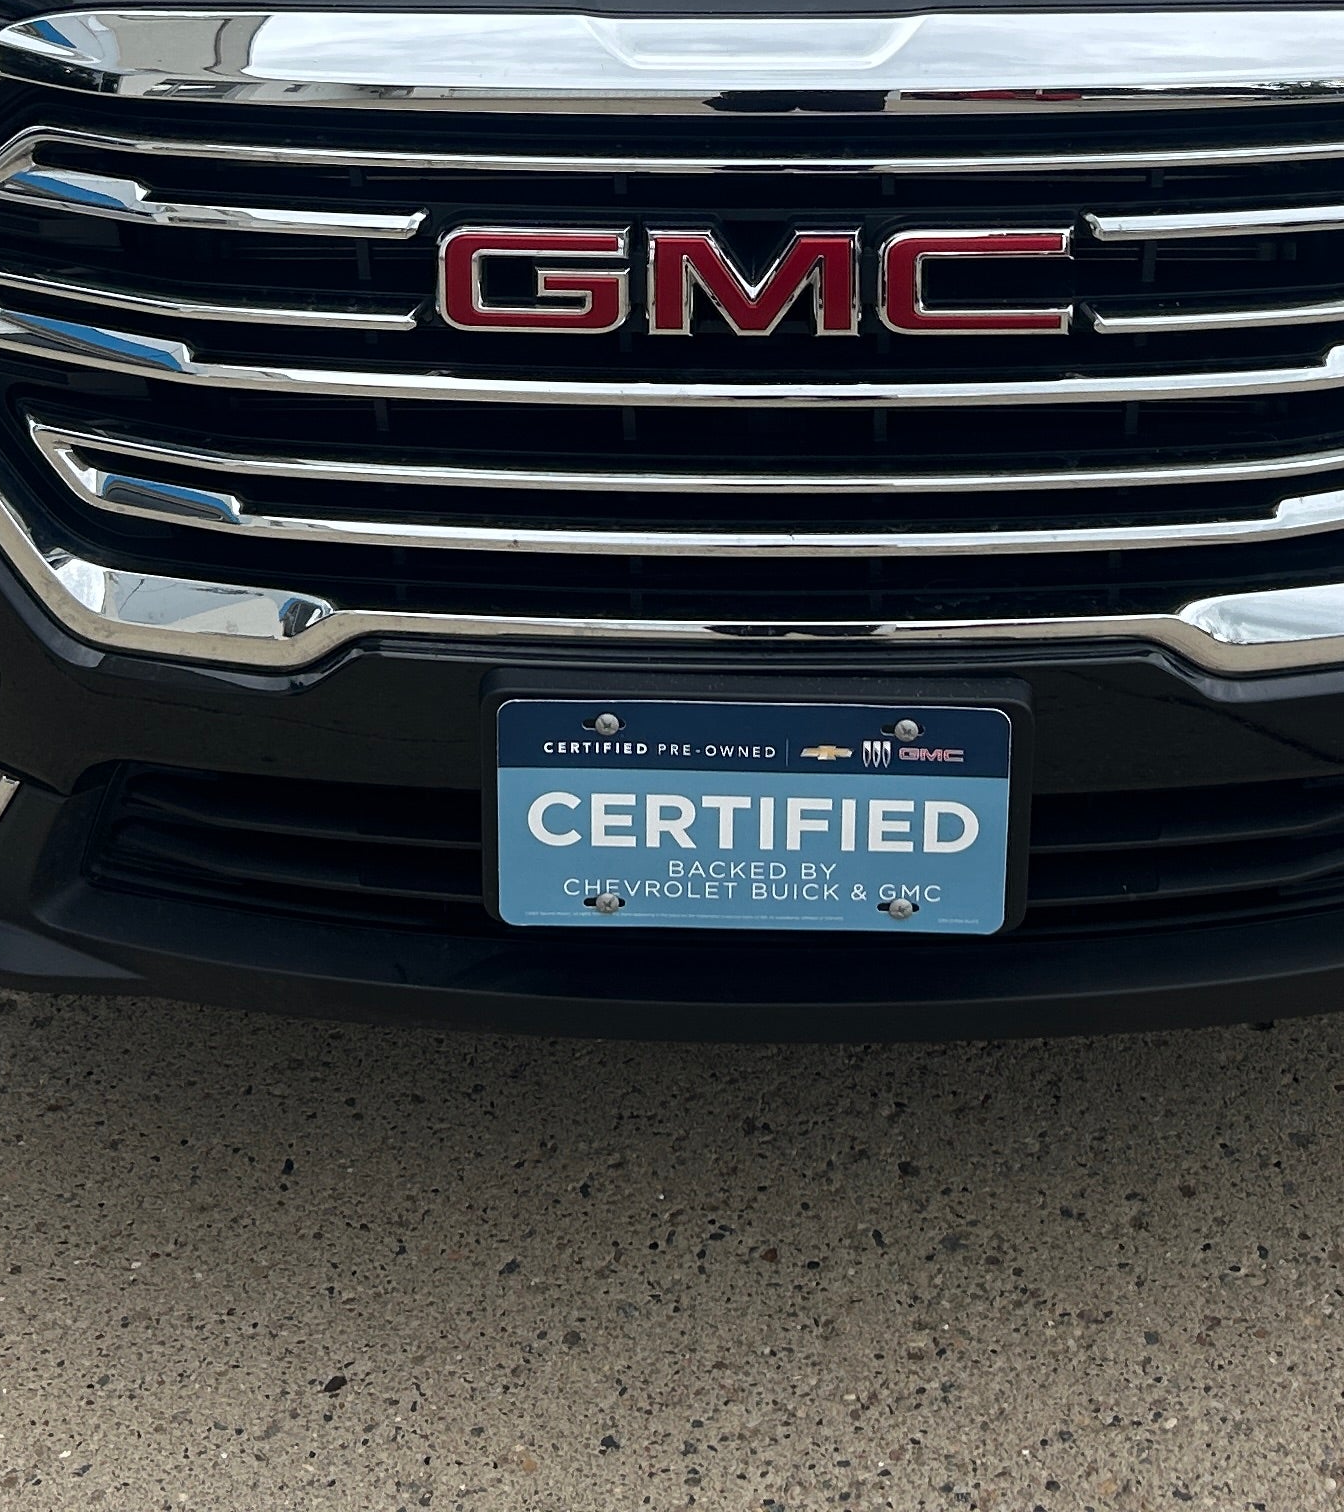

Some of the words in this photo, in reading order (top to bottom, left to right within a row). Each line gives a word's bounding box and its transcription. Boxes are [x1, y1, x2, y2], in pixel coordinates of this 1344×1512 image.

[436, 225, 1074, 338] GMC
[543, 741, 649, 756] CERTIFIED
[657, 742, 777, 759] PRE-OWNED
[898, 746, 965, 763] GMC
[527, 791, 980, 854] CERTIFIED
[668, 860, 788, 880] BACKED
[800, 862, 838, 881] BY
[562, 878, 738, 900] CHEVROLET
[751, 882, 840, 901] BUICK
[850, 883, 868, 902] &
[878, 883, 942, 903] GMC
